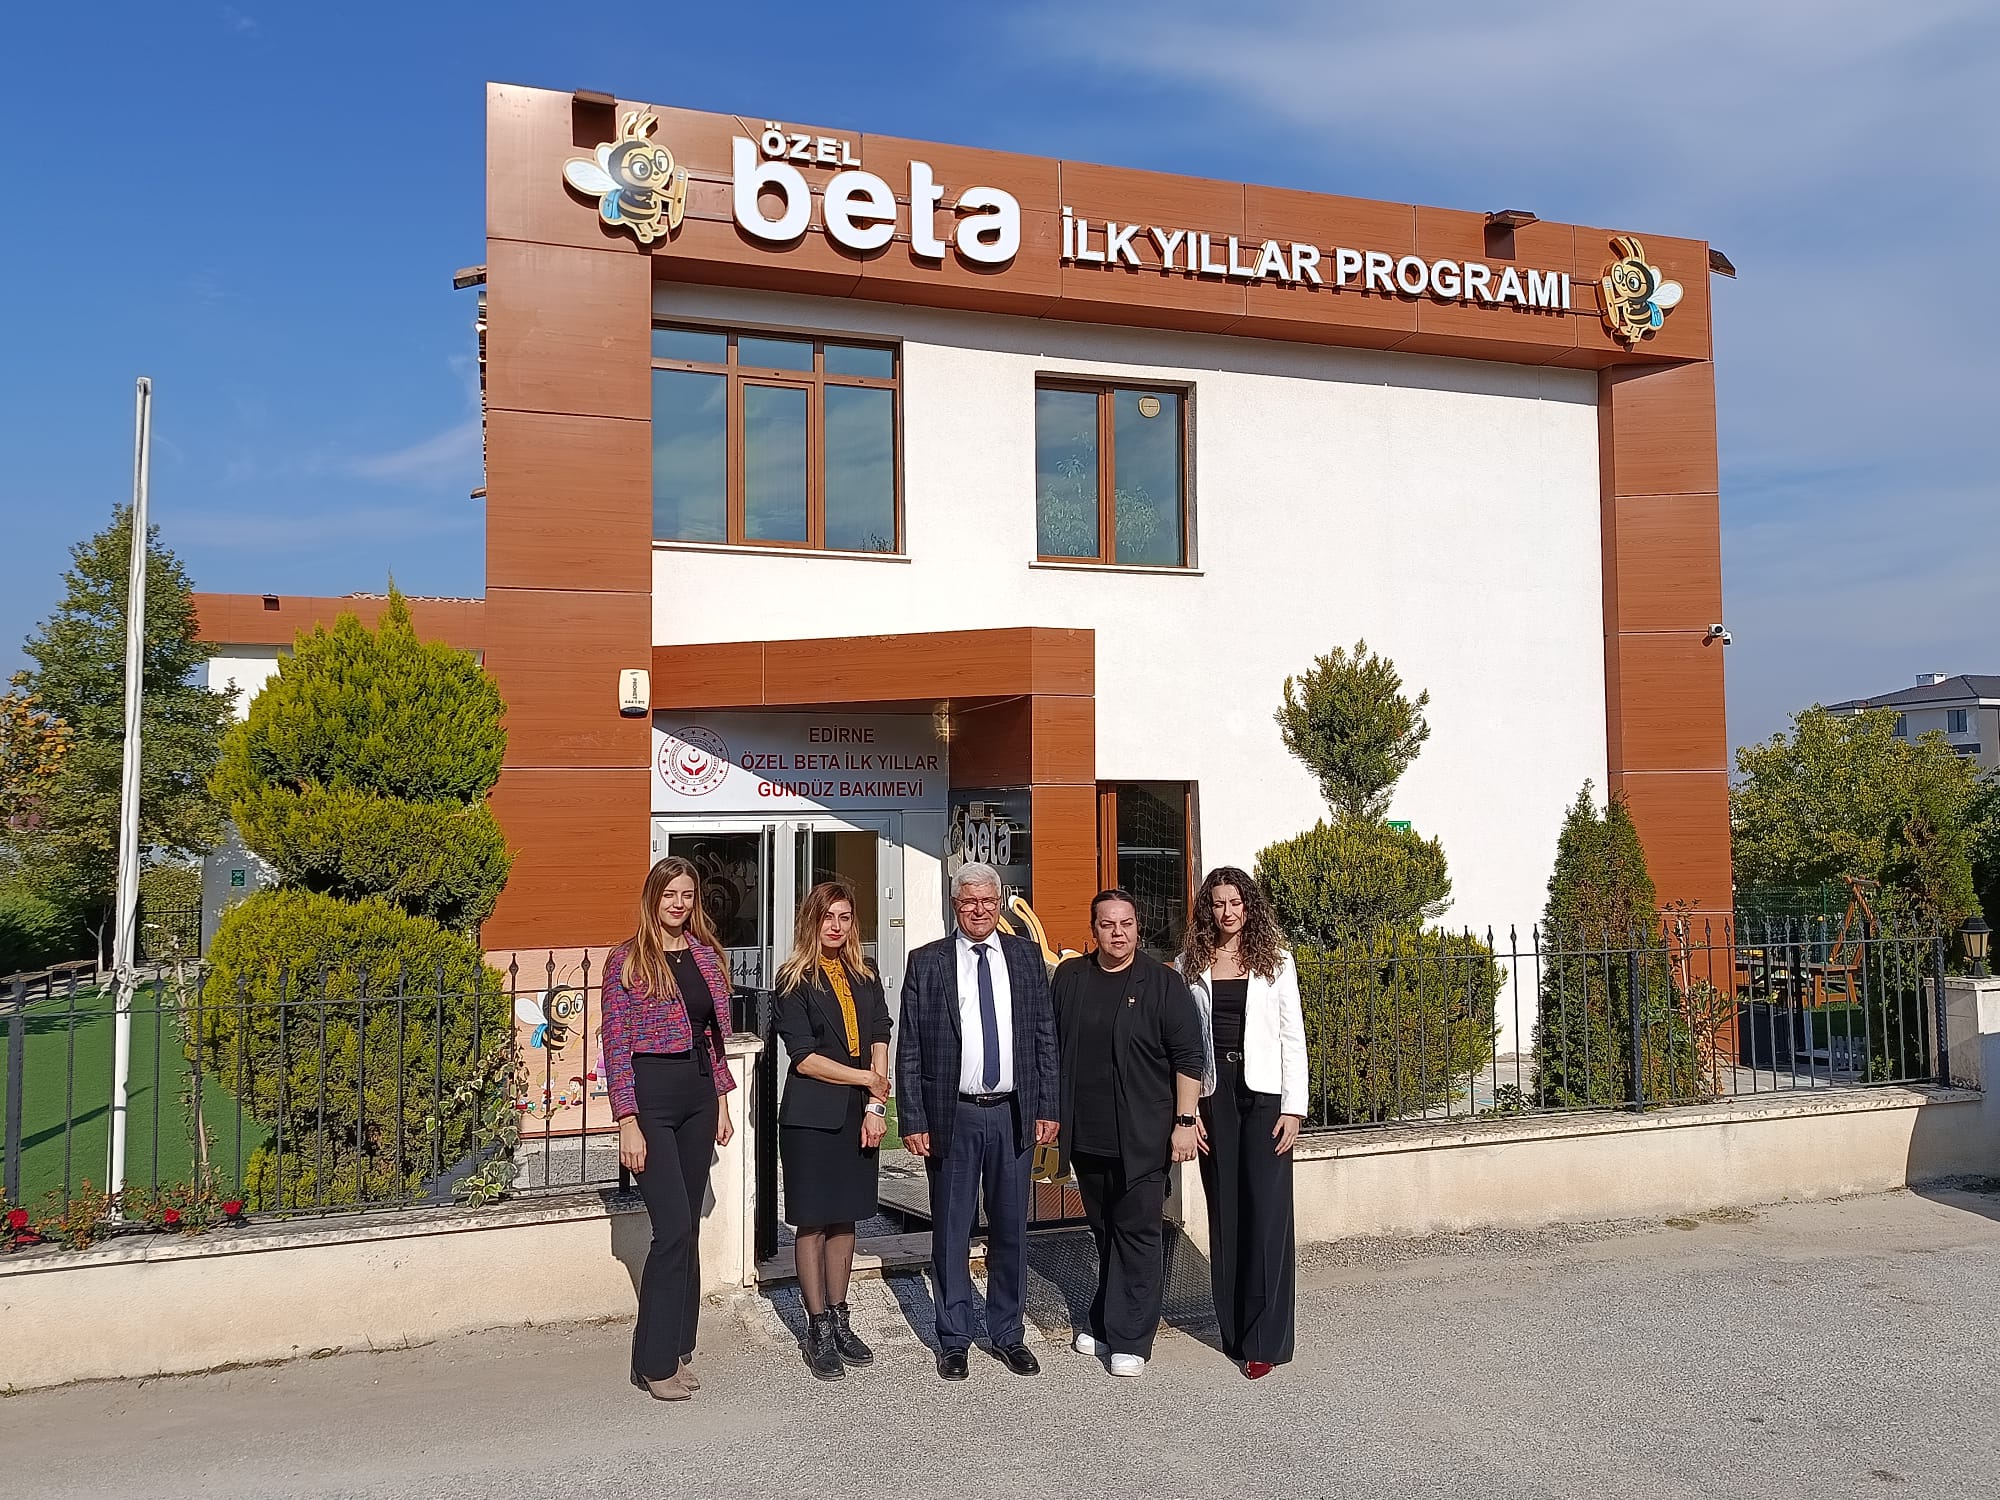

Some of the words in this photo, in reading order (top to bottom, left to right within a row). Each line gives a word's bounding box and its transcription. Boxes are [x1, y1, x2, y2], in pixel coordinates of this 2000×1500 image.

[761, 120, 861, 166] ÖZEL
[733, 136, 1020, 264] beta
[1062, 206, 1141, 266] İLK
[1150, 227, 1324, 284] YILLAR
[1336, 247, 1571, 310] PROGRAMI
[809, 725, 875, 743] EDİRNE
[741, 751, 788, 770] ÖZEL
[794, 754, 840, 770] BETA
[845, 752, 872, 770] İLK
[877, 755, 939, 770] YILLAR
[757, 778, 834, 797] GÜNDÜZ
[839, 778, 923, 797] BAKIMEVİ
[964, 812, 1011, 866] beta
